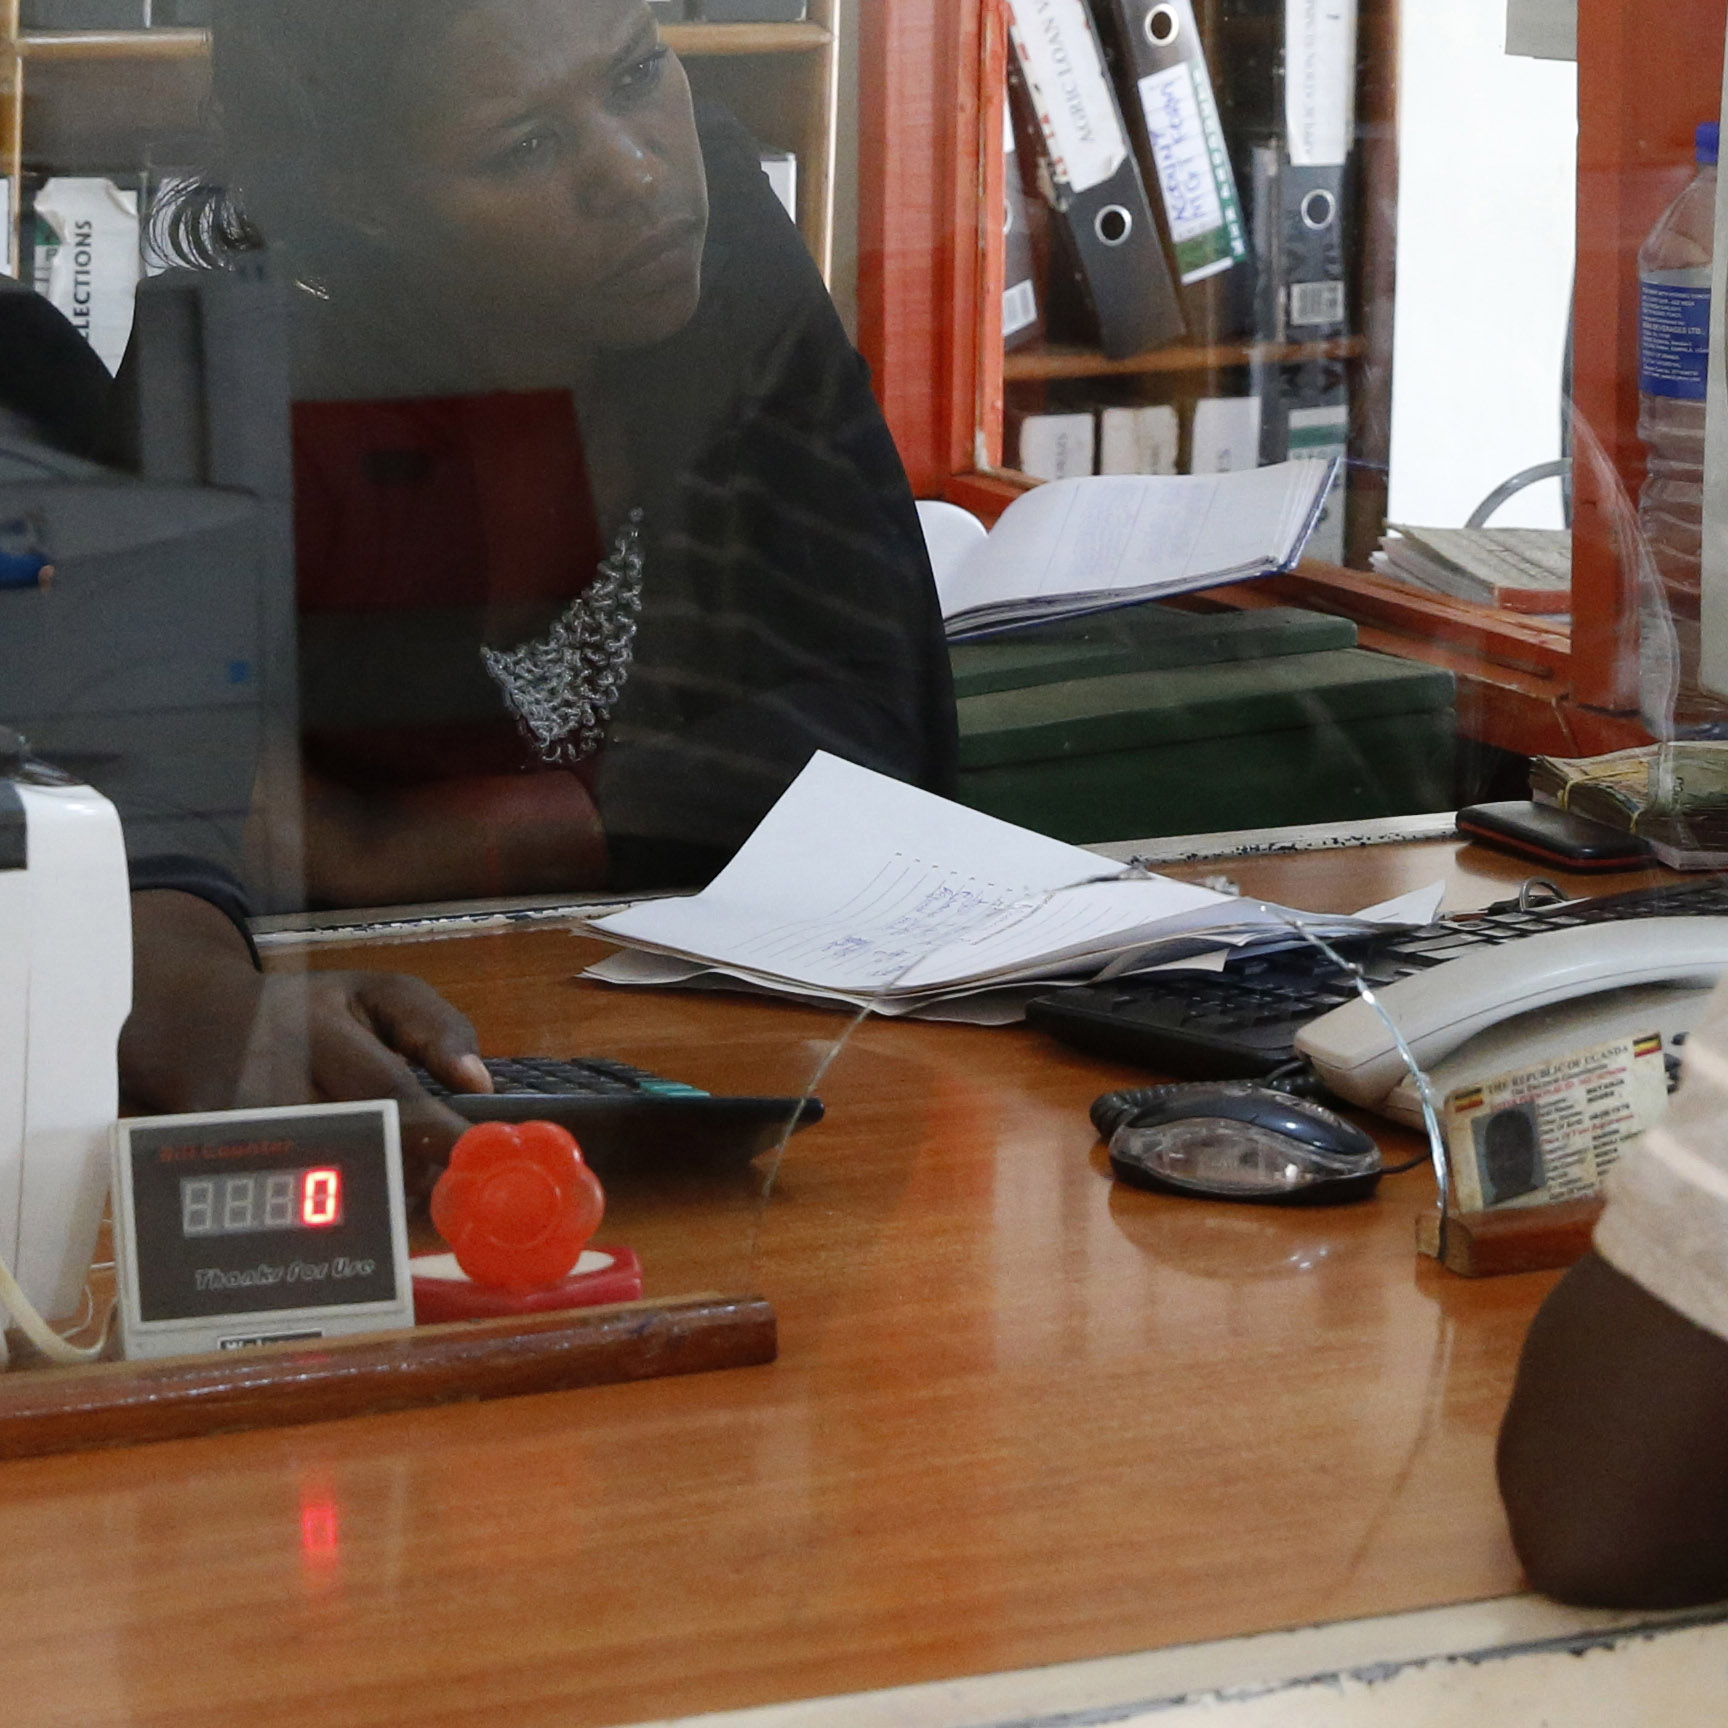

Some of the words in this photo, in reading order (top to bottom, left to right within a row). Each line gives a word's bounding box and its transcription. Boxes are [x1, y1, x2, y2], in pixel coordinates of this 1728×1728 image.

[1045, 17, 1072, 77] LOAN
[1062, 80, 1094, 142] AGRIC
[1512, 1064, 1566, 1087] REPUBLIC
[1567, 1059, 1583, 1071] OF
[1585, 1045, 1628, 1065] UGANDA
[302, 1168, 339, 1227] 0
